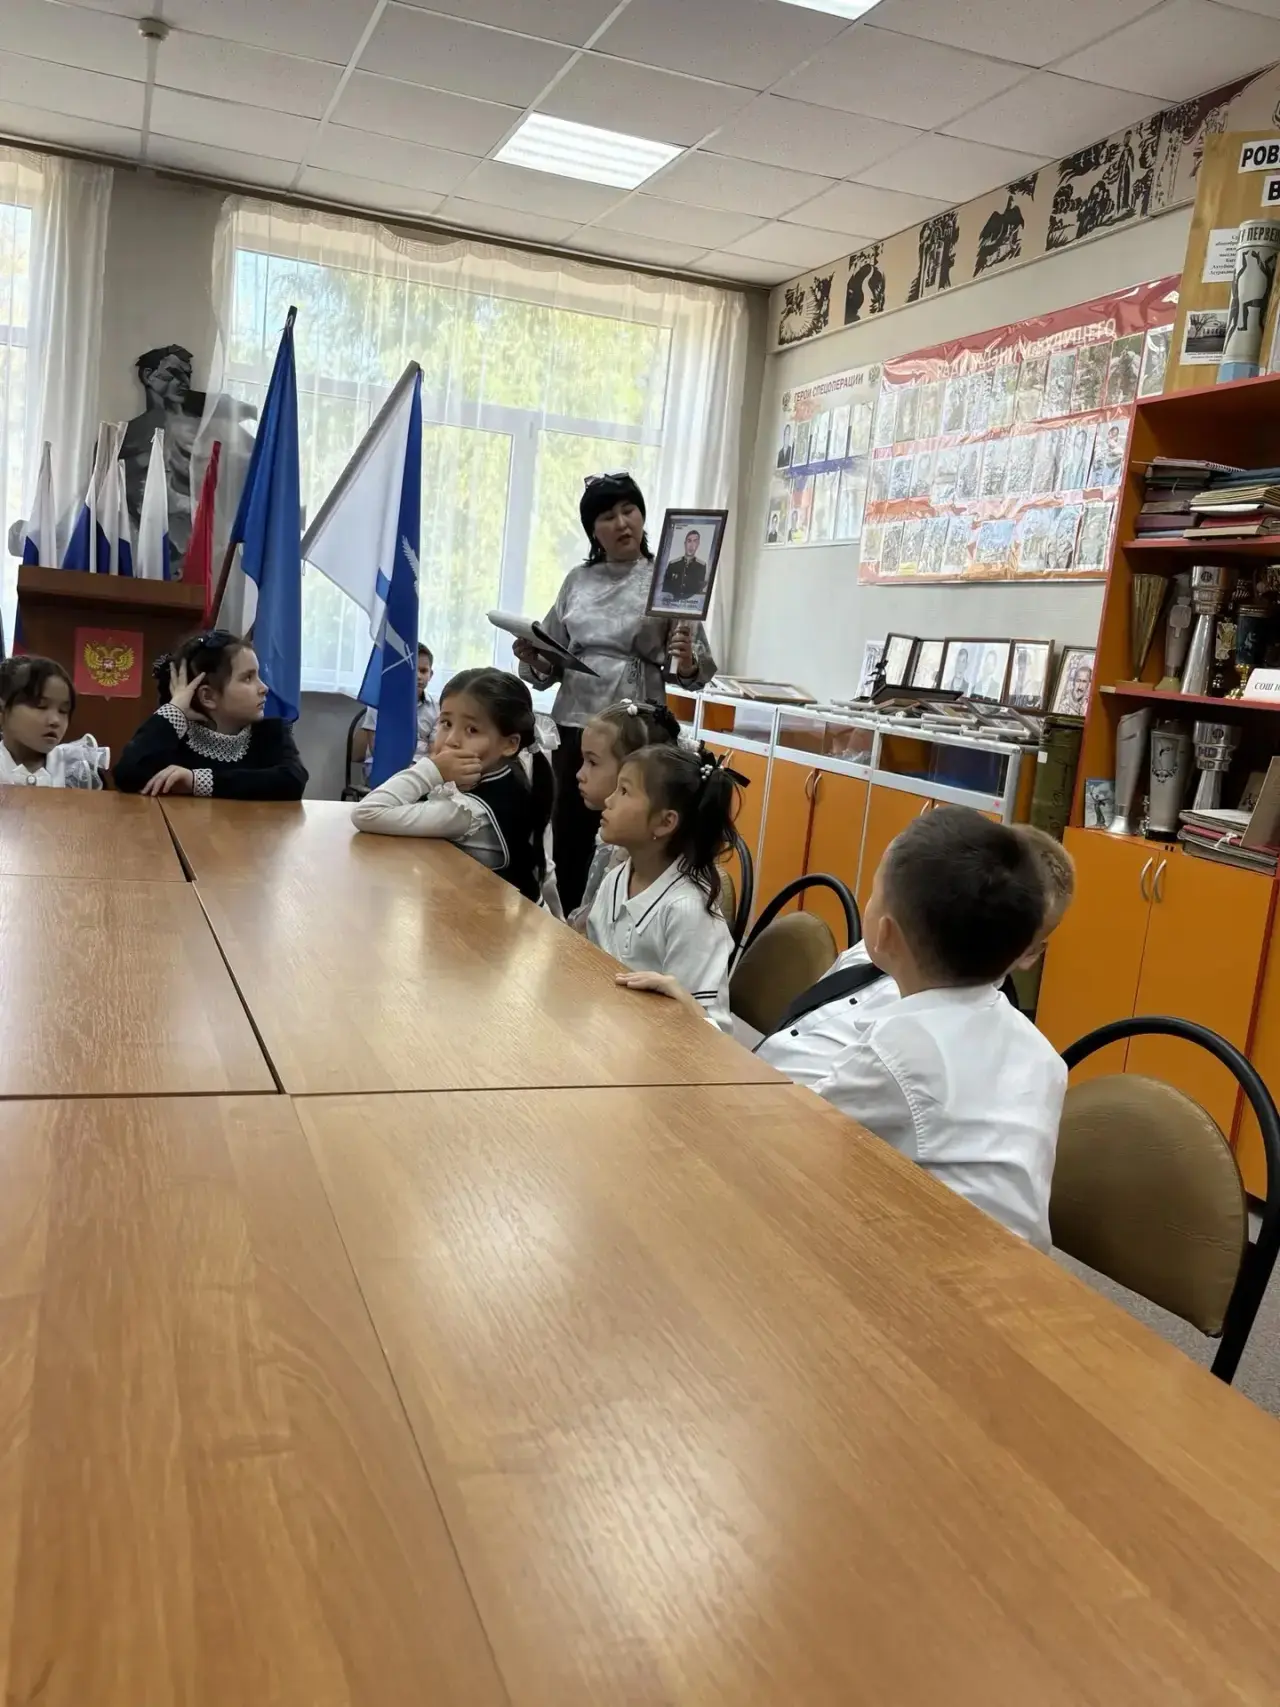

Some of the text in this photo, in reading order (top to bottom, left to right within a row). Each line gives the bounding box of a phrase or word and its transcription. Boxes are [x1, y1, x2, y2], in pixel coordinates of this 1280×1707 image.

[1241, 145, 1280, 167] РОВ
[812, 373, 864, 397] СПЕЦОПЕРАЦИИ
[1254, 682, 1274, 691] СОШ
